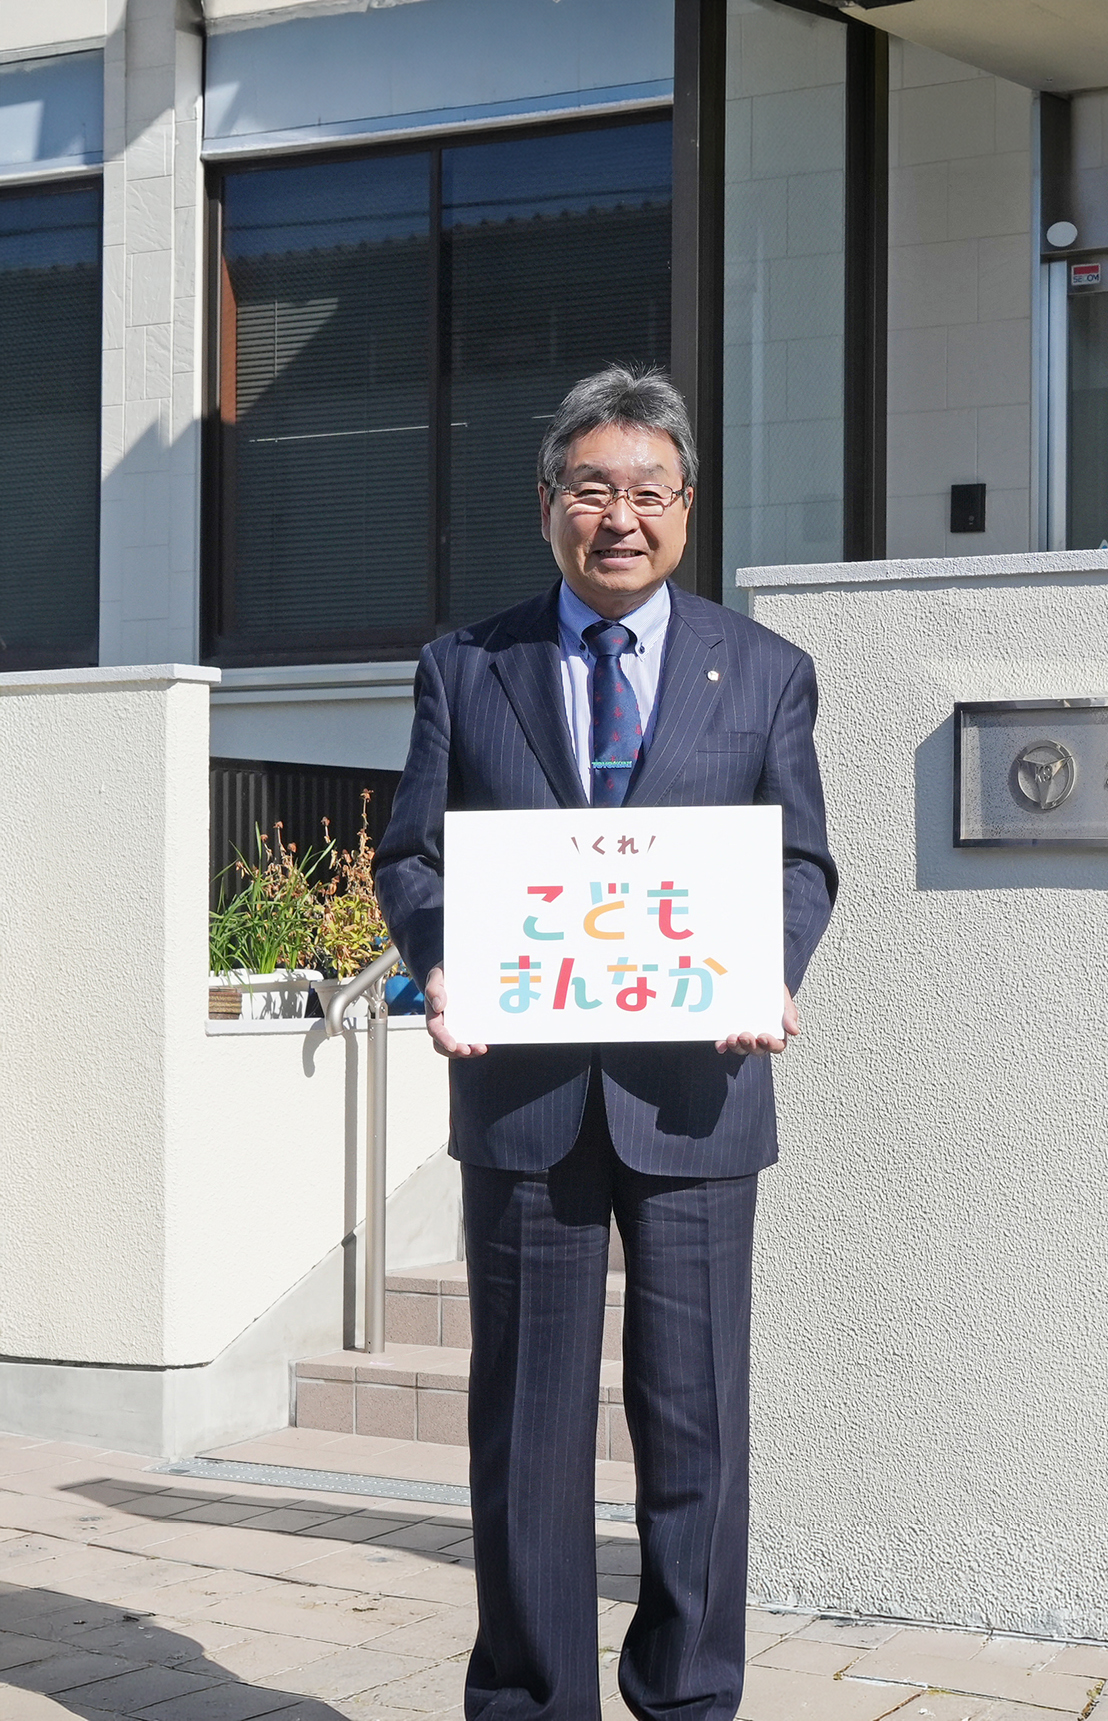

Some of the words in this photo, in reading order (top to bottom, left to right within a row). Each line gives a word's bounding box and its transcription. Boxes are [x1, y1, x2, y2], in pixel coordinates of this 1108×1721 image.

[591, 835, 639, 855] くれ
[523, 881, 694, 940] こども
[498, 955, 728, 1013] まんなか
